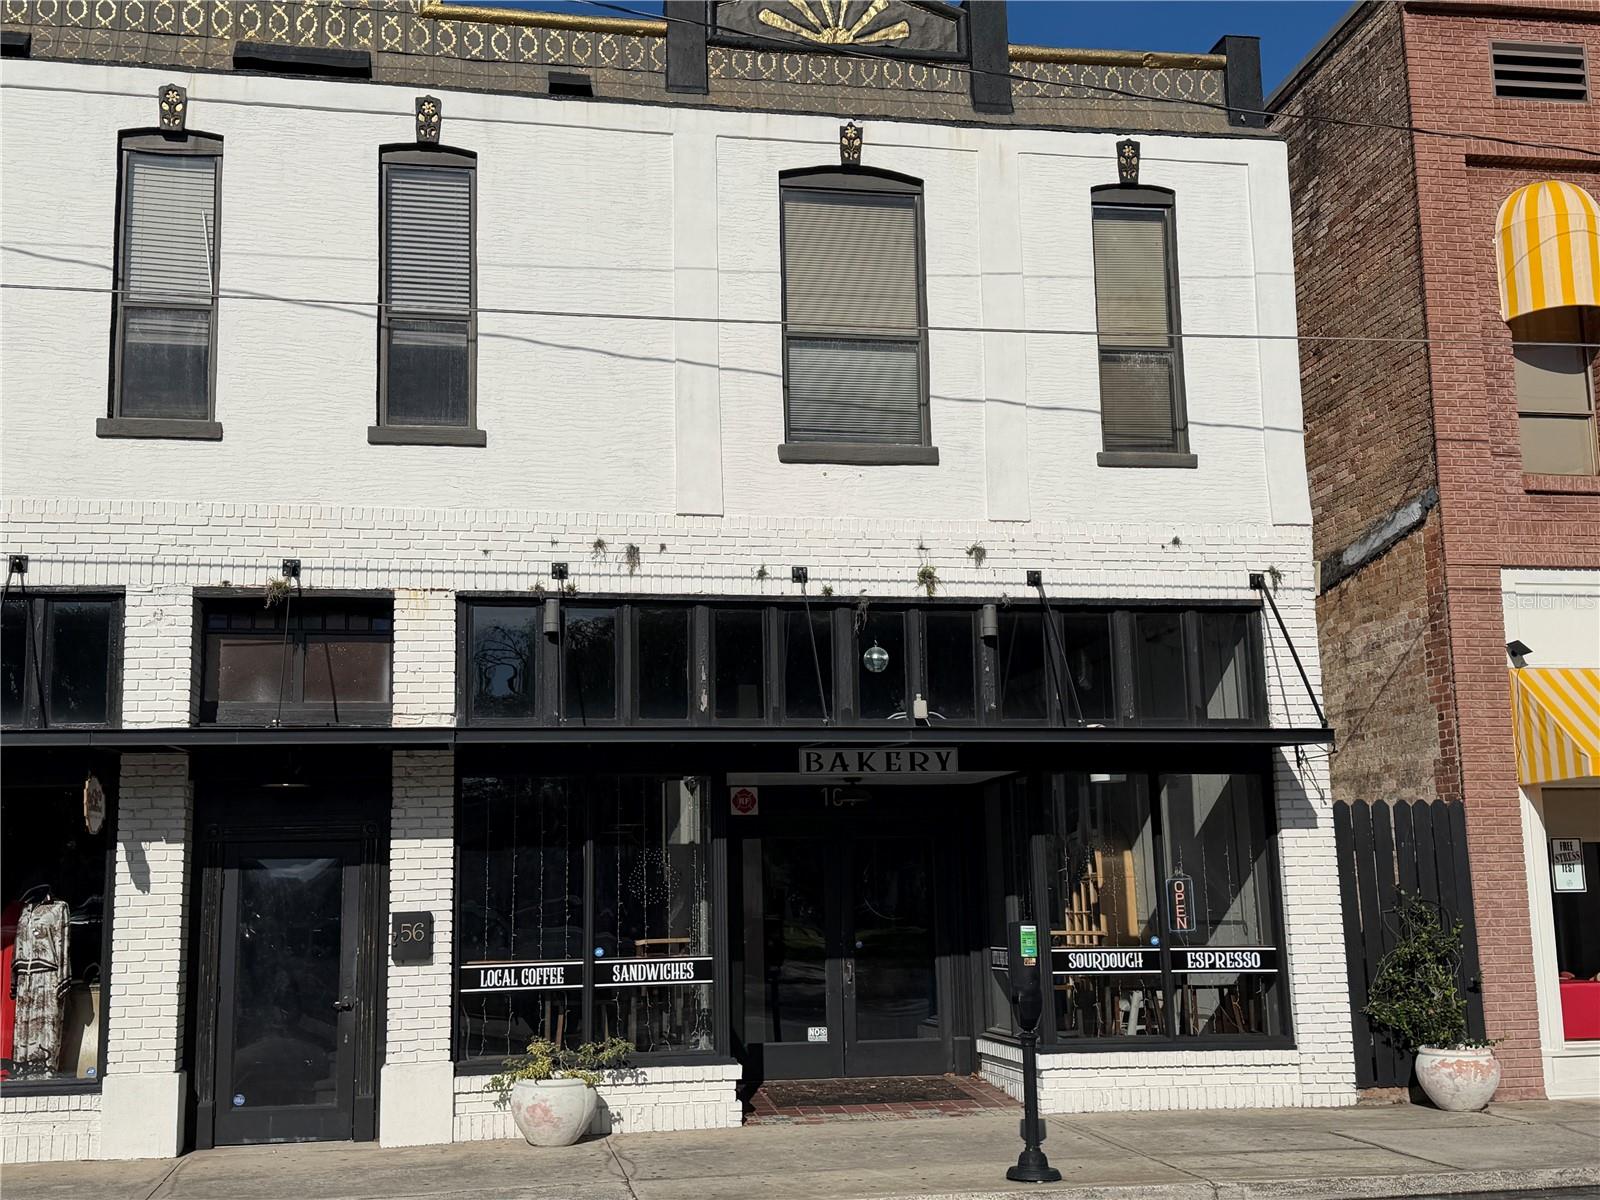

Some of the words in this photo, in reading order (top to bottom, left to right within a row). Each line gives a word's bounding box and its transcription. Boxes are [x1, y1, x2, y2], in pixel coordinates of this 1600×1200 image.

[805, 751, 952, 772] BAKERY
[1560, 841, 1573, 851] FREE
[1555, 851, 1580, 863] STRESS
[1561, 863, 1575, 873] TEST
[1174, 881, 1188, 929] OPEN
[1068, 951, 1144, 971] SOURDOUGH
[1186, 951, 1261, 969] ESPRESSO
[480, 969, 518, 988] LOCAL
[521, 966, 565, 986] COFFEE
[612, 962, 695, 982] SANDWICHES
